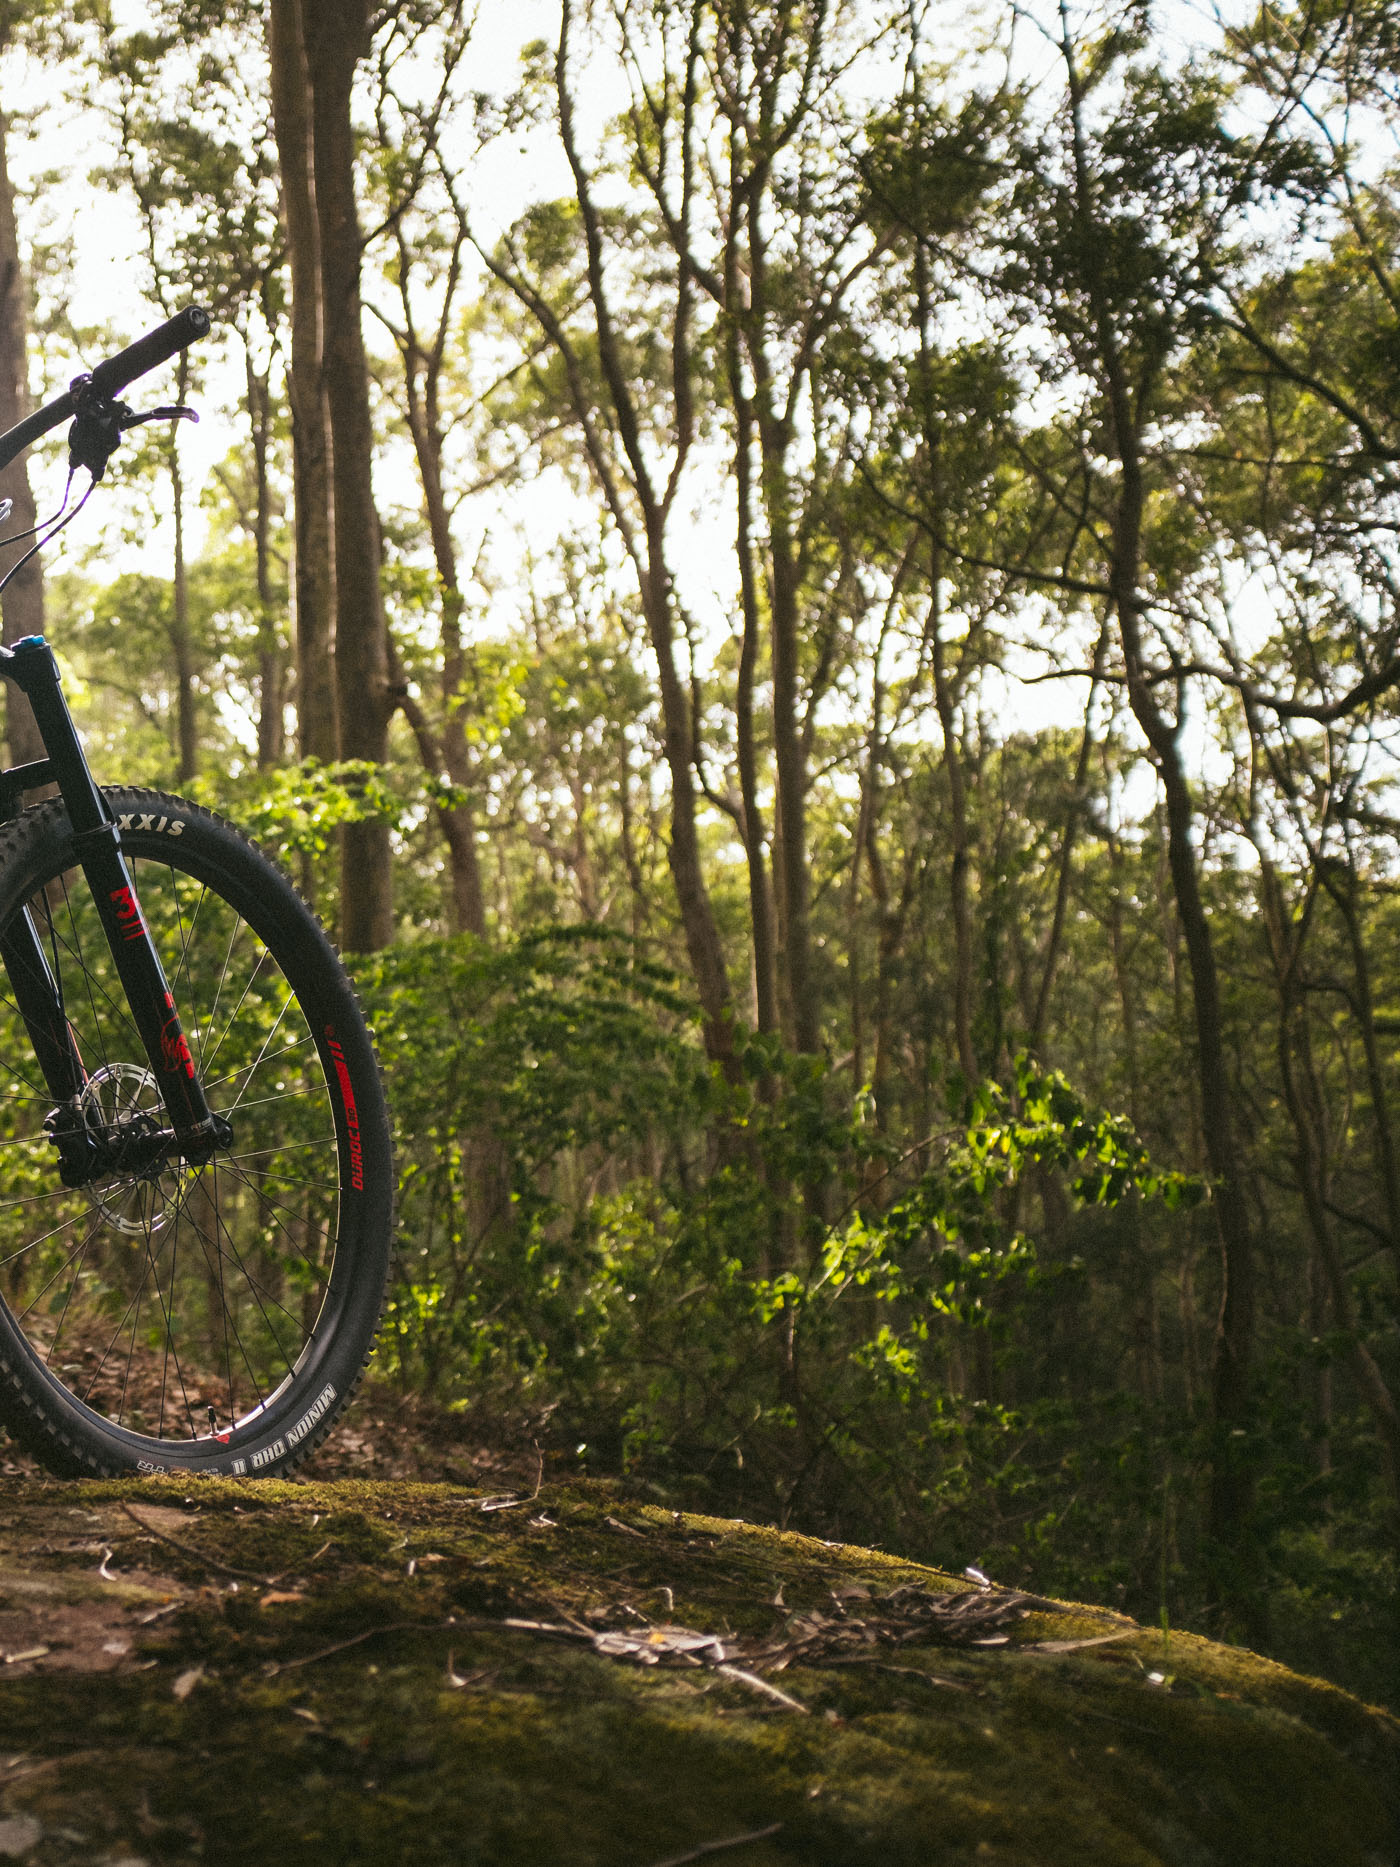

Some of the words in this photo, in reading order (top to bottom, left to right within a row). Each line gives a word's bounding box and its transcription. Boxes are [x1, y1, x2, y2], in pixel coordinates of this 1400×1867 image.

[118, 813, 186, 836] XXIS
[285, 1383, 338, 1449] MINION
[231, 1458, 247, 1477] II
[250, 1438, 287, 1470] DHR
